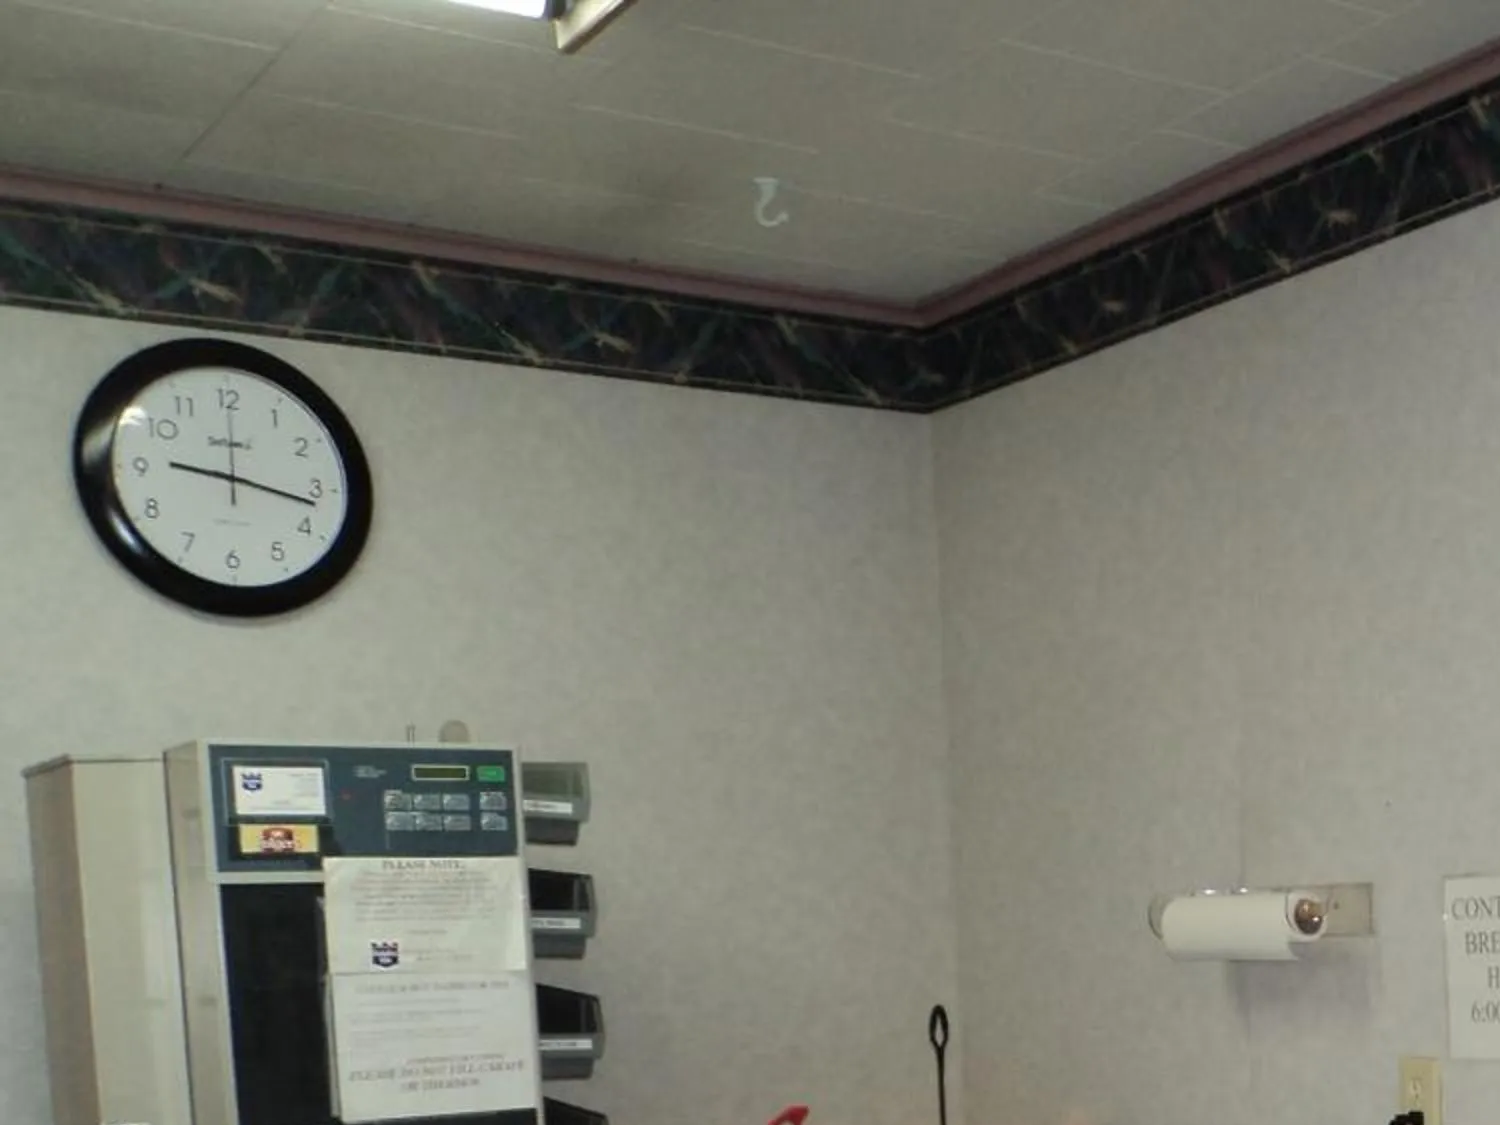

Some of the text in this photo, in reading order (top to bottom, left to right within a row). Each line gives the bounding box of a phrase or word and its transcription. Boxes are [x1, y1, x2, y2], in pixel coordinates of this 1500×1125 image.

[174, 396, 194, 417] 11
[217, 388, 240, 411] 12
[270, 408, 279, 429] 1
[147, 418, 179, 440] 10
[293, 437, 310, 457] 2
[132, 457, 149, 477] 9
[308, 479, 323, 499] 3
[144, 498, 160, 519] 8
[297, 516, 311, 536] 4
[180, 531, 195, 552] 7
[270, 542, 285, 561] 5
[225, 550, 240, 570] 6
